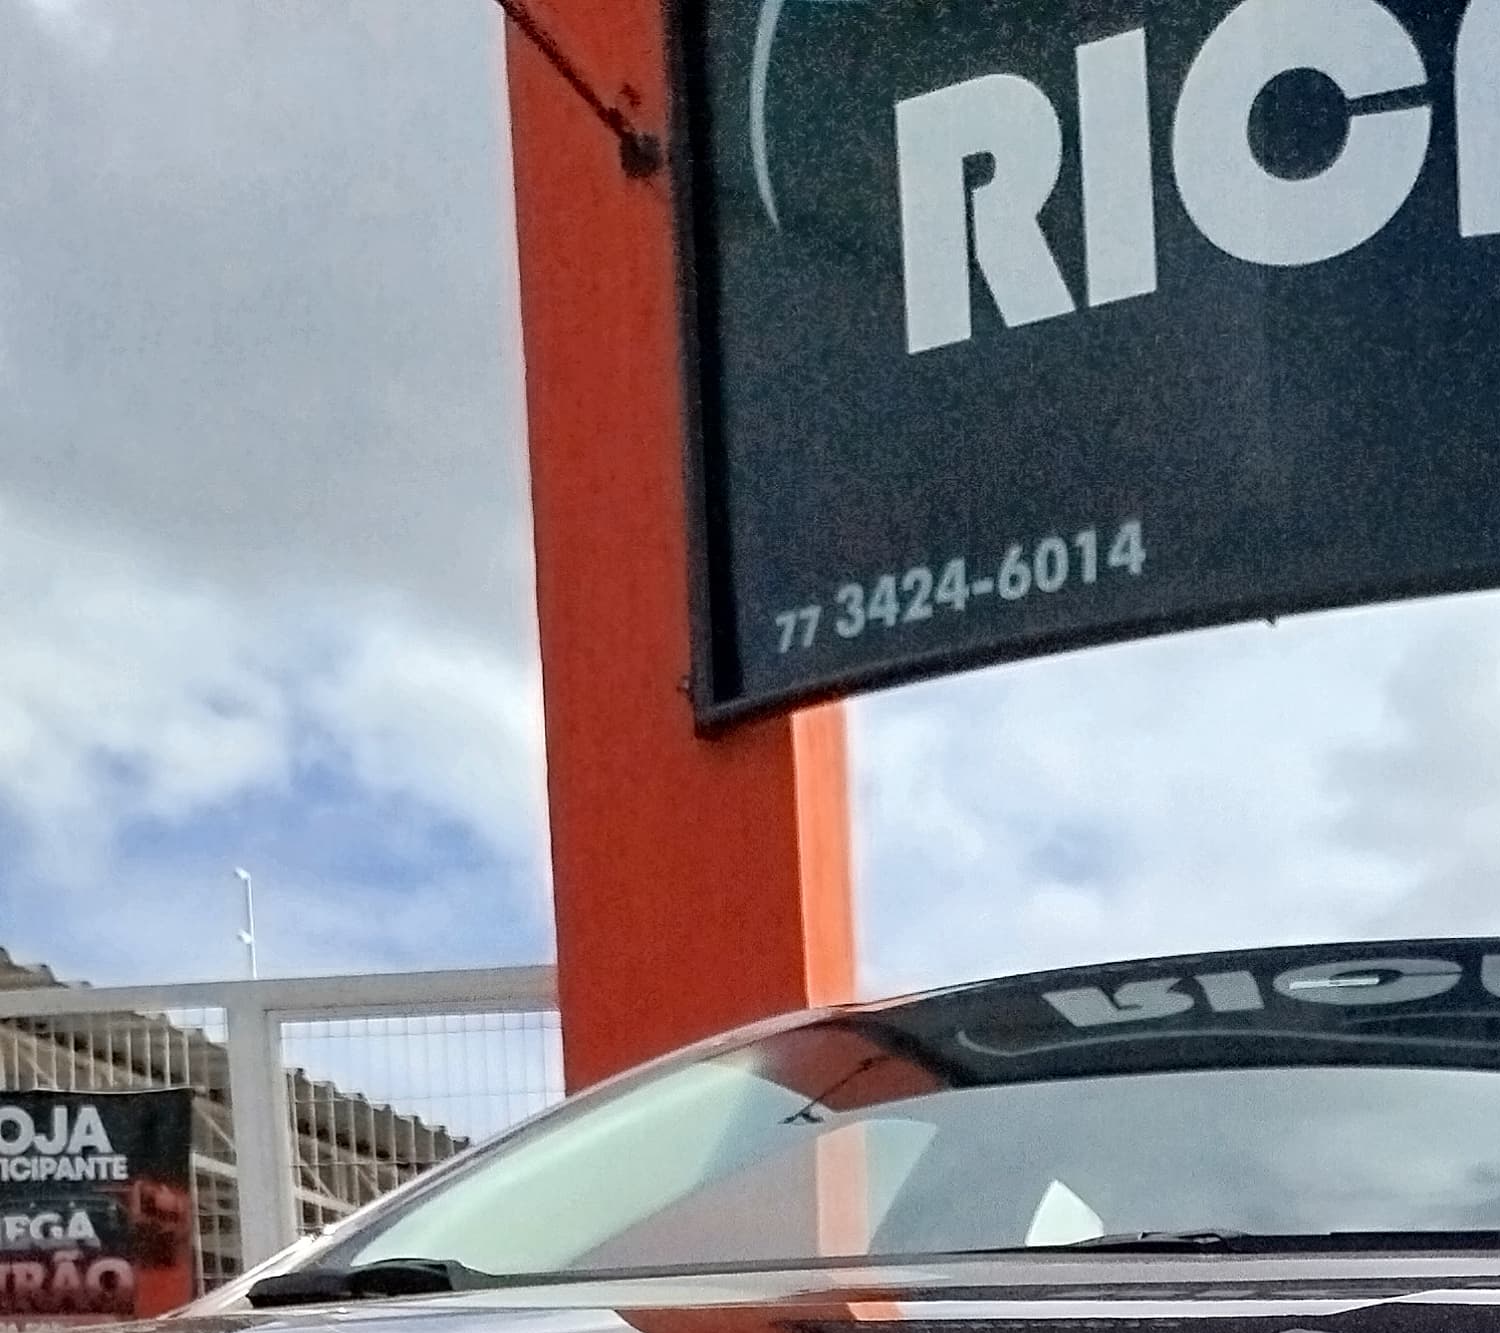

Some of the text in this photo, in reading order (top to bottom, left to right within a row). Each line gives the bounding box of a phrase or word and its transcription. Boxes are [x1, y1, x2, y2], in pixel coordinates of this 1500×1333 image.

[775, 519, 1147, 654] 77 3424-6014
[0, 1104, 114, 1155] OJA
